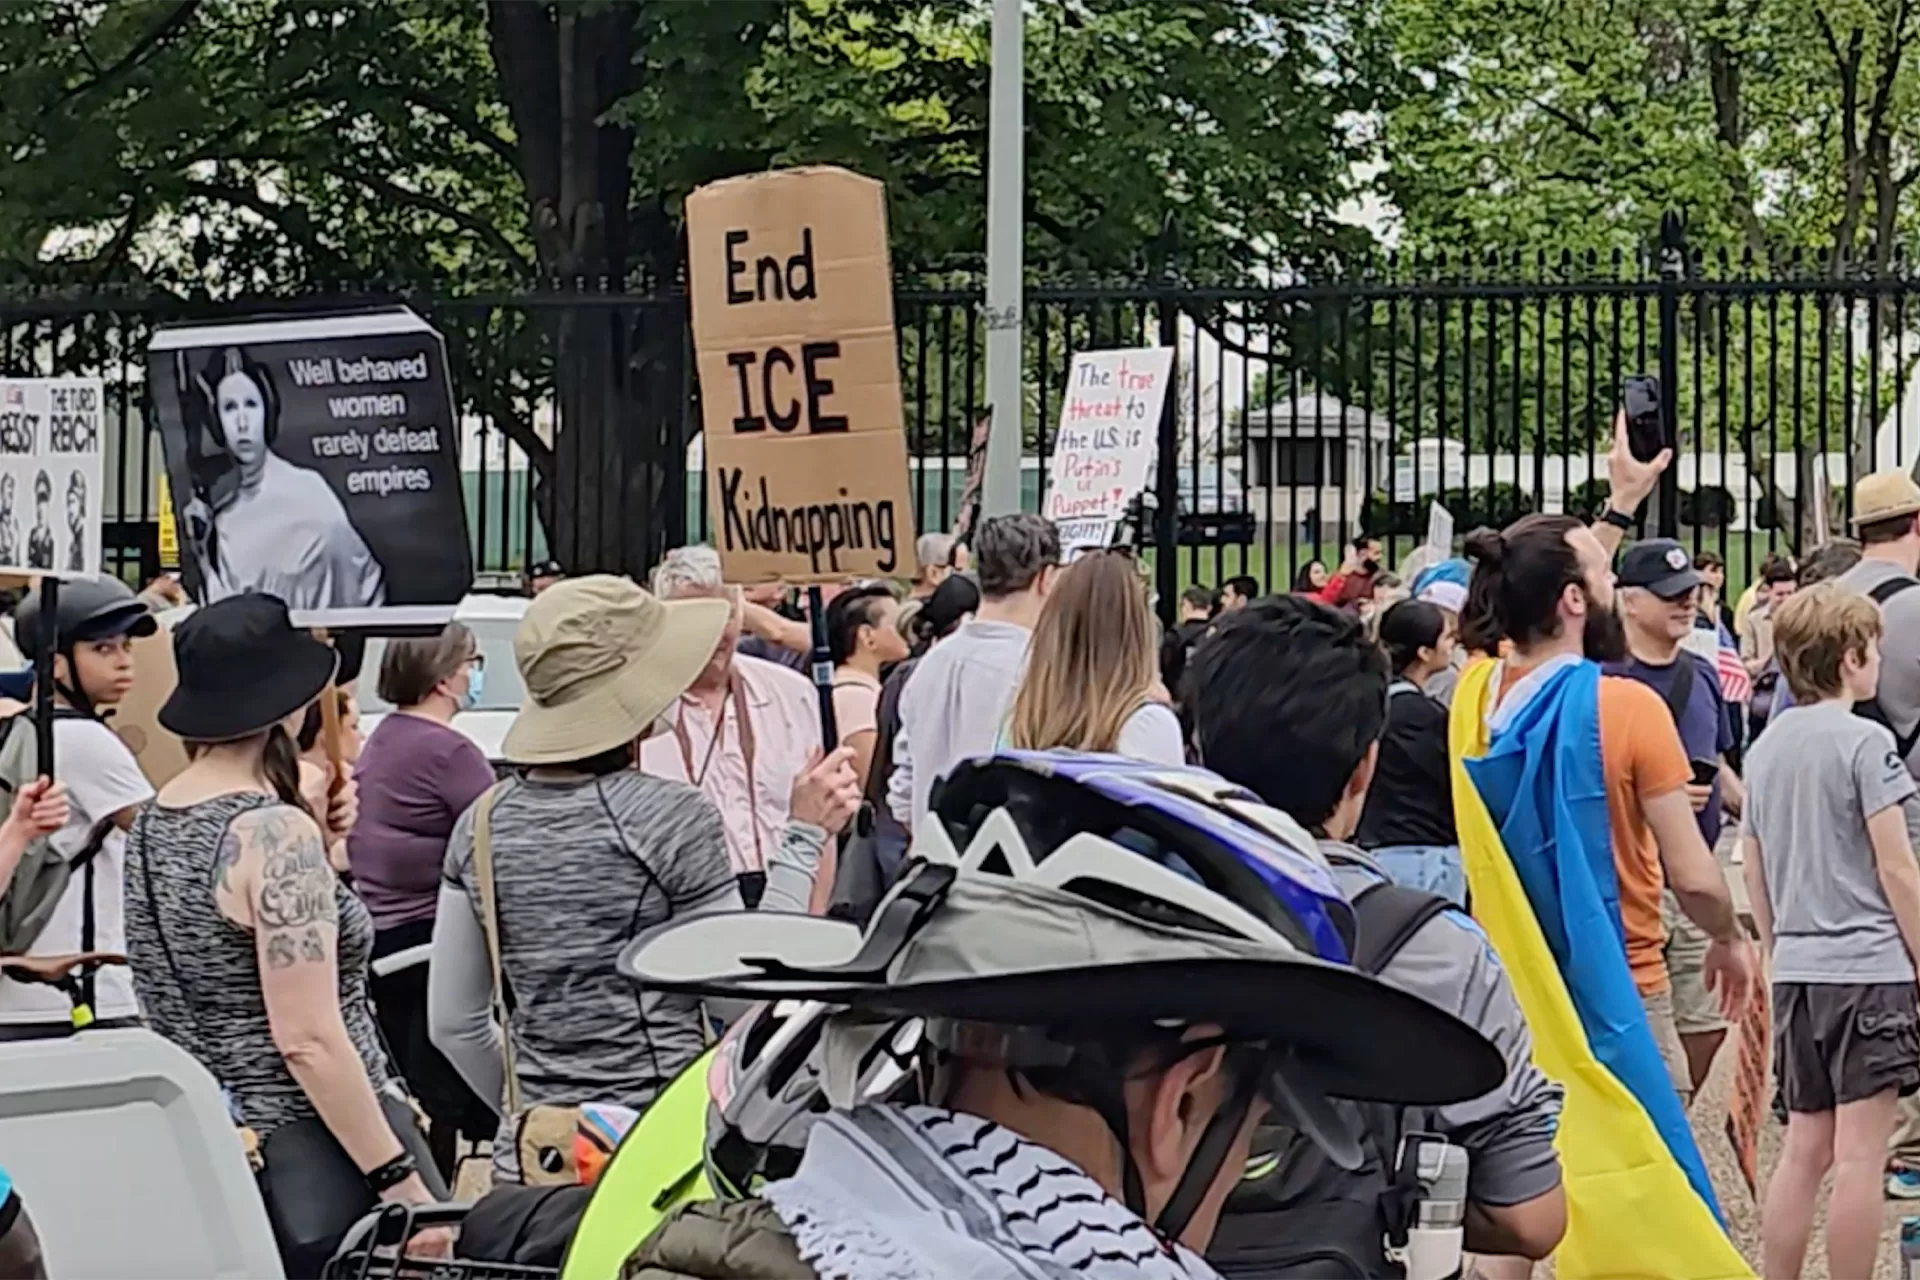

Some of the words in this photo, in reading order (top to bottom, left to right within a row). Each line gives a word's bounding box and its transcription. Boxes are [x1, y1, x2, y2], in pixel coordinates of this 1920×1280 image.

[725, 227, 817, 305] End
[289, 358, 335, 386] Well
[336, 352, 428, 383] behaved
[1079, 362, 1110, 387] The
[1118, 358, 1155, 389] true
[727, 342, 849, 434] ICE
[328, 394, 406, 418] women
[1068, 396, 1121, 420] threat
[1126, 395, 1145, 420] to
[312, 429, 369, 461] rarely
[373, 426, 440, 454] defeat
[1060, 430, 1088, 450] the
[1125, 429, 1141, 448] is
[347, 465, 431, 497] empires
[1064, 453, 1121, 478] Putin's
[718, 467, 896, 574] Kidnapping
